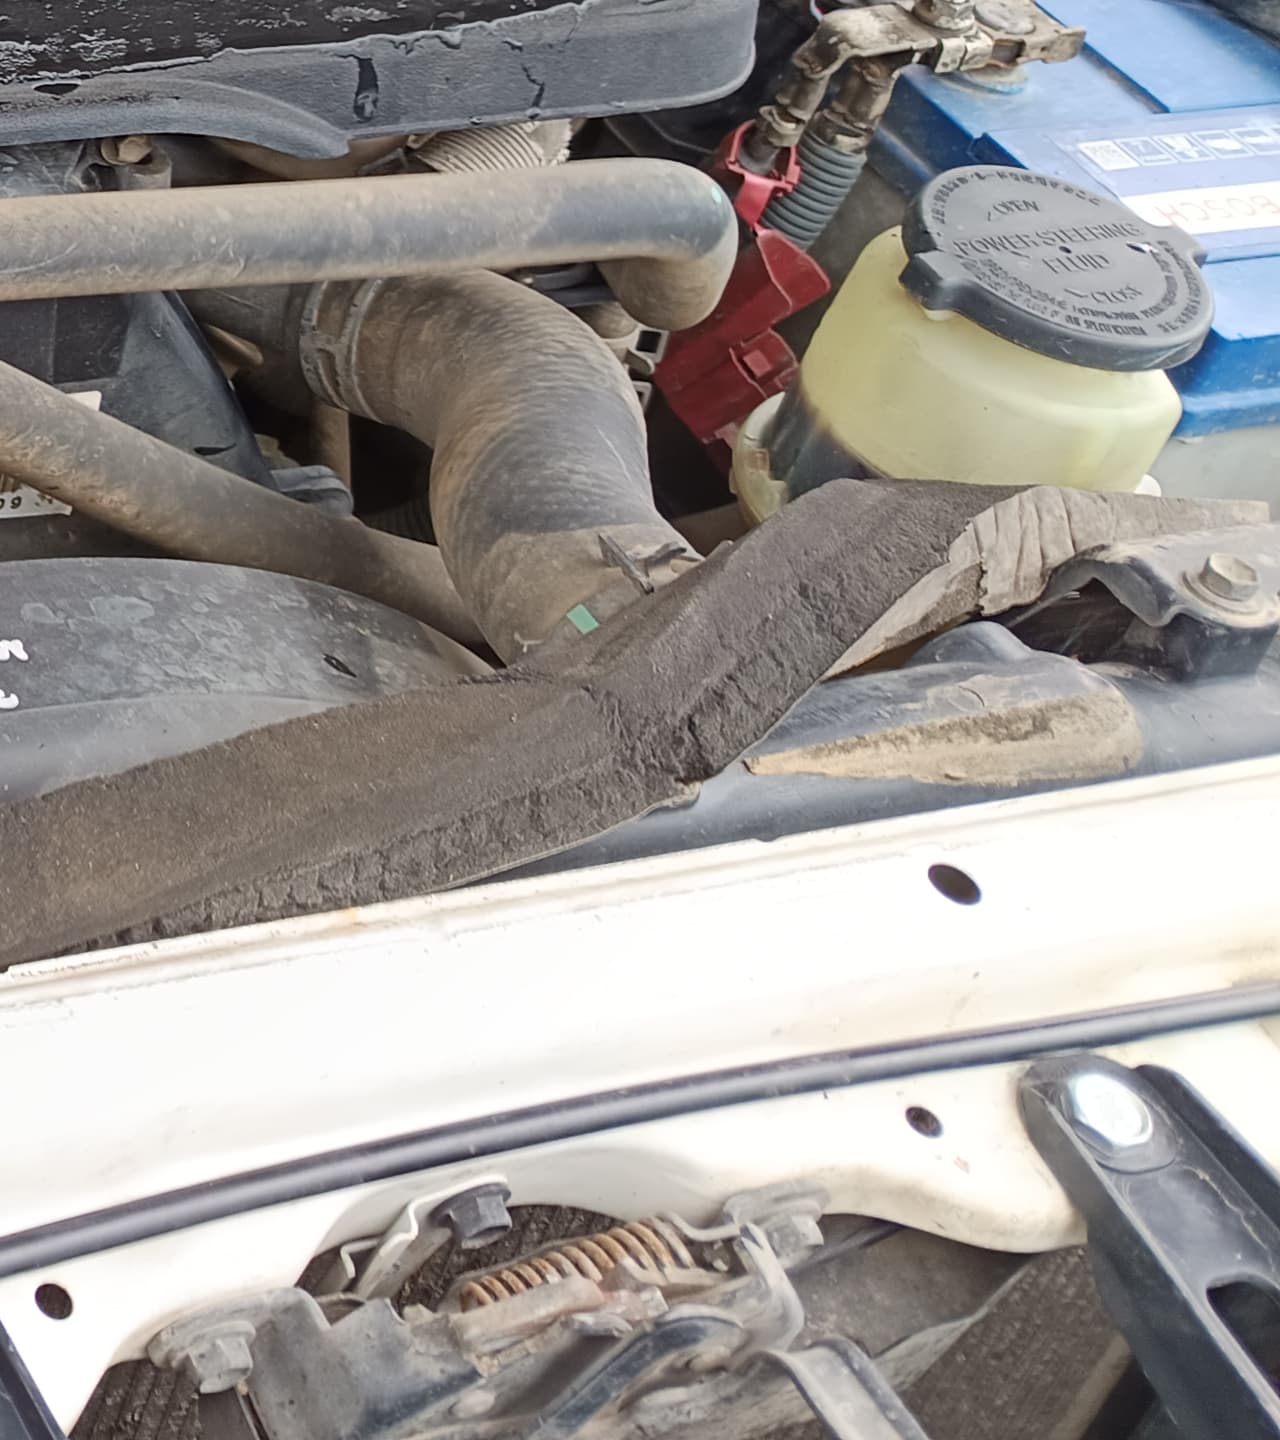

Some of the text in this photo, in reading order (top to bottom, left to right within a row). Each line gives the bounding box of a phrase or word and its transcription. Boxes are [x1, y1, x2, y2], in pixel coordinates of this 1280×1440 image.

[953, 222, 1144, 258] POWER STEERING
[1042, 253, 1111, 276] FLUID
